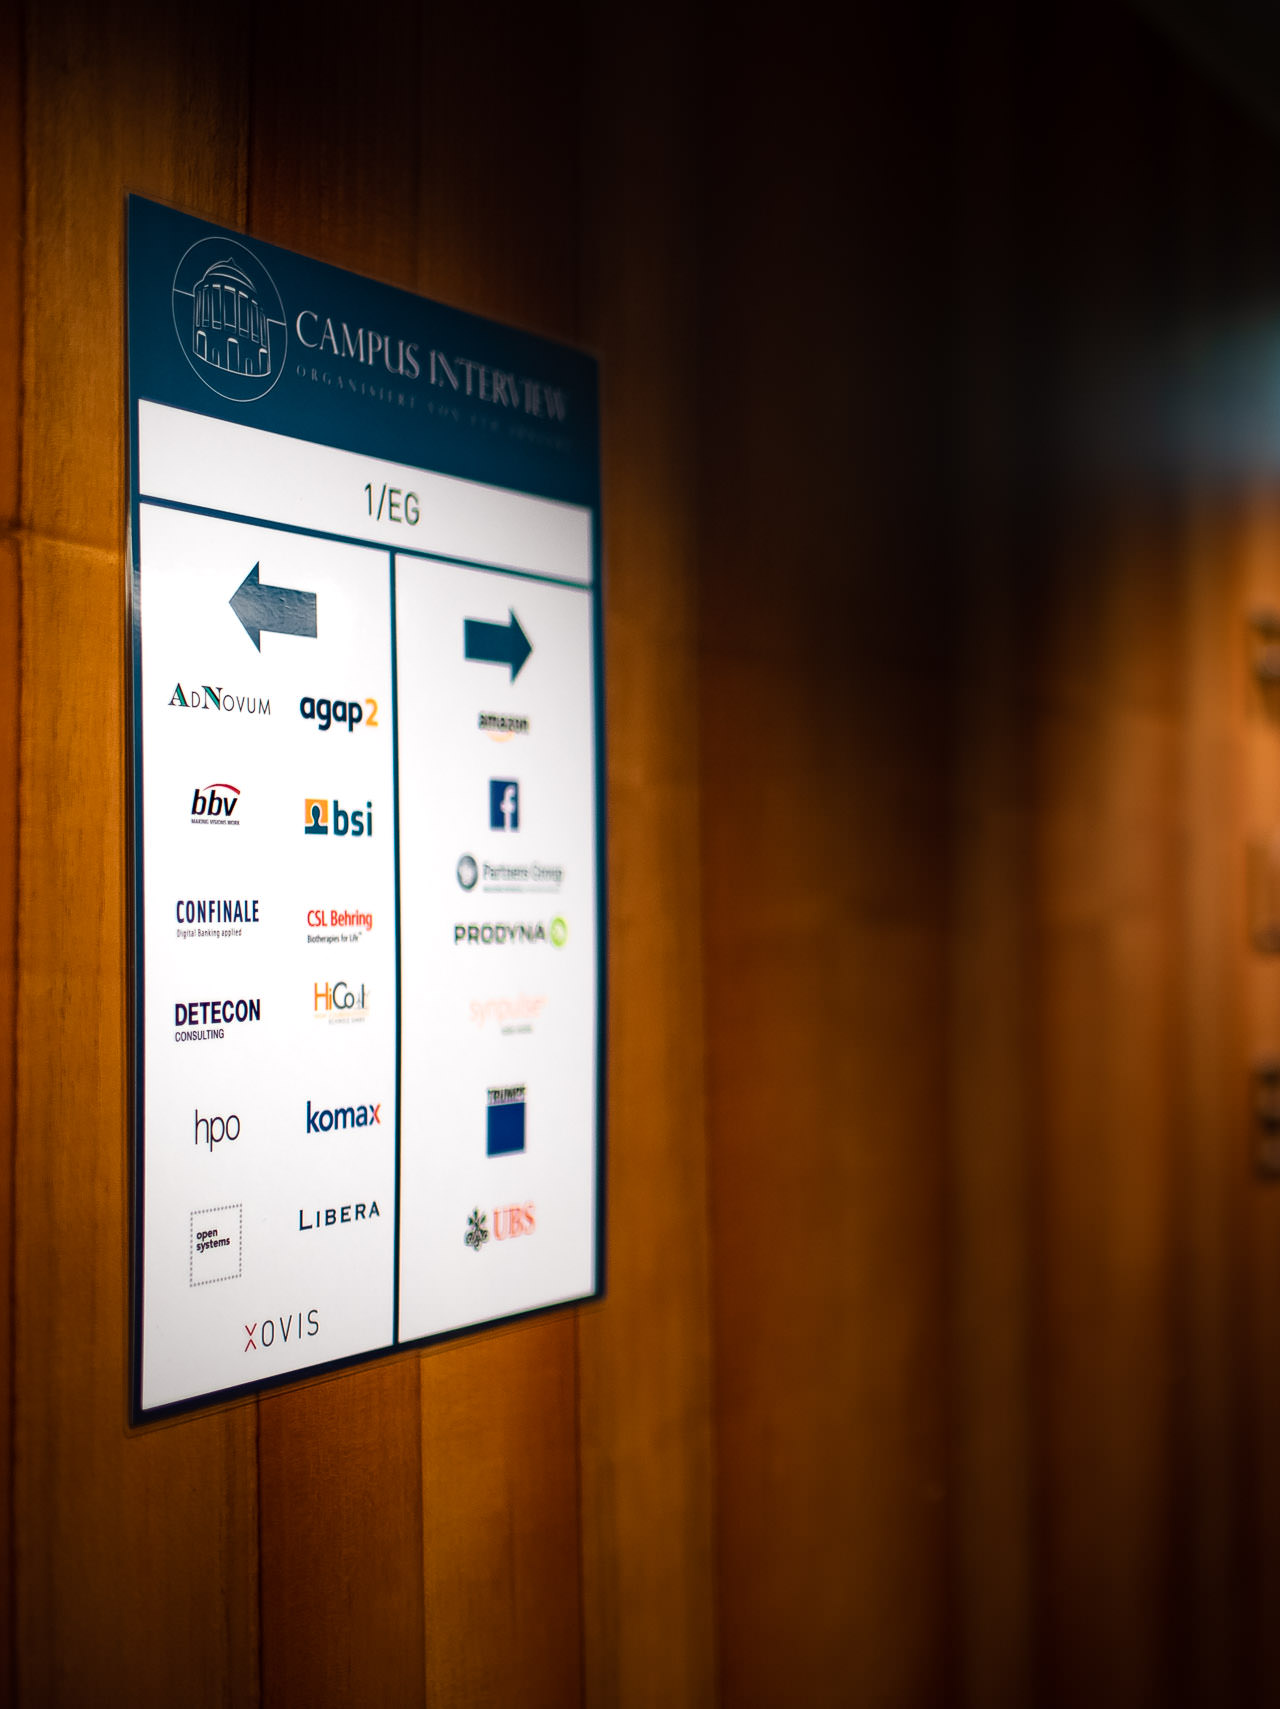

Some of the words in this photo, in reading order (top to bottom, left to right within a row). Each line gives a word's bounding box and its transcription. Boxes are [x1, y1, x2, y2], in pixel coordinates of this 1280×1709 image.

[296, 310, 421, 379] CAMPUS
[429, 348, 568, 422] INTERVIEW
[364, 482, 421, 526] 1/EG
[300, 696, 379, 732] agap2
[478, 711, 531, 735] amazon
[191, 788, 238, 817] bbv
[333, 799, 373, 837] bsi
[176, 899, 260, 924] CONFINALE
[307, 909, 328, 928] CSL
[330, 909, 373, 932] Behring
[176, 928, 197, 939] Digital
[197, 928, 220, 939] Banking
[221, 928, 242, 938] applied
[454, 919, 547, 946] PRODYNA
[175, 999, 261, 1027] DETECON
[175, 1028, 225, 1042] CONSULTING
[195, 1108, 241, 1152] hpo
[306, 1100, 381, 1134] komax
[196, 1228, 218, 1241] open
[493, 1201, 536, 1241] UBS
[196, 1236, 230, 1253] systems
[244, 1309, 320, 1353] XOVIS
